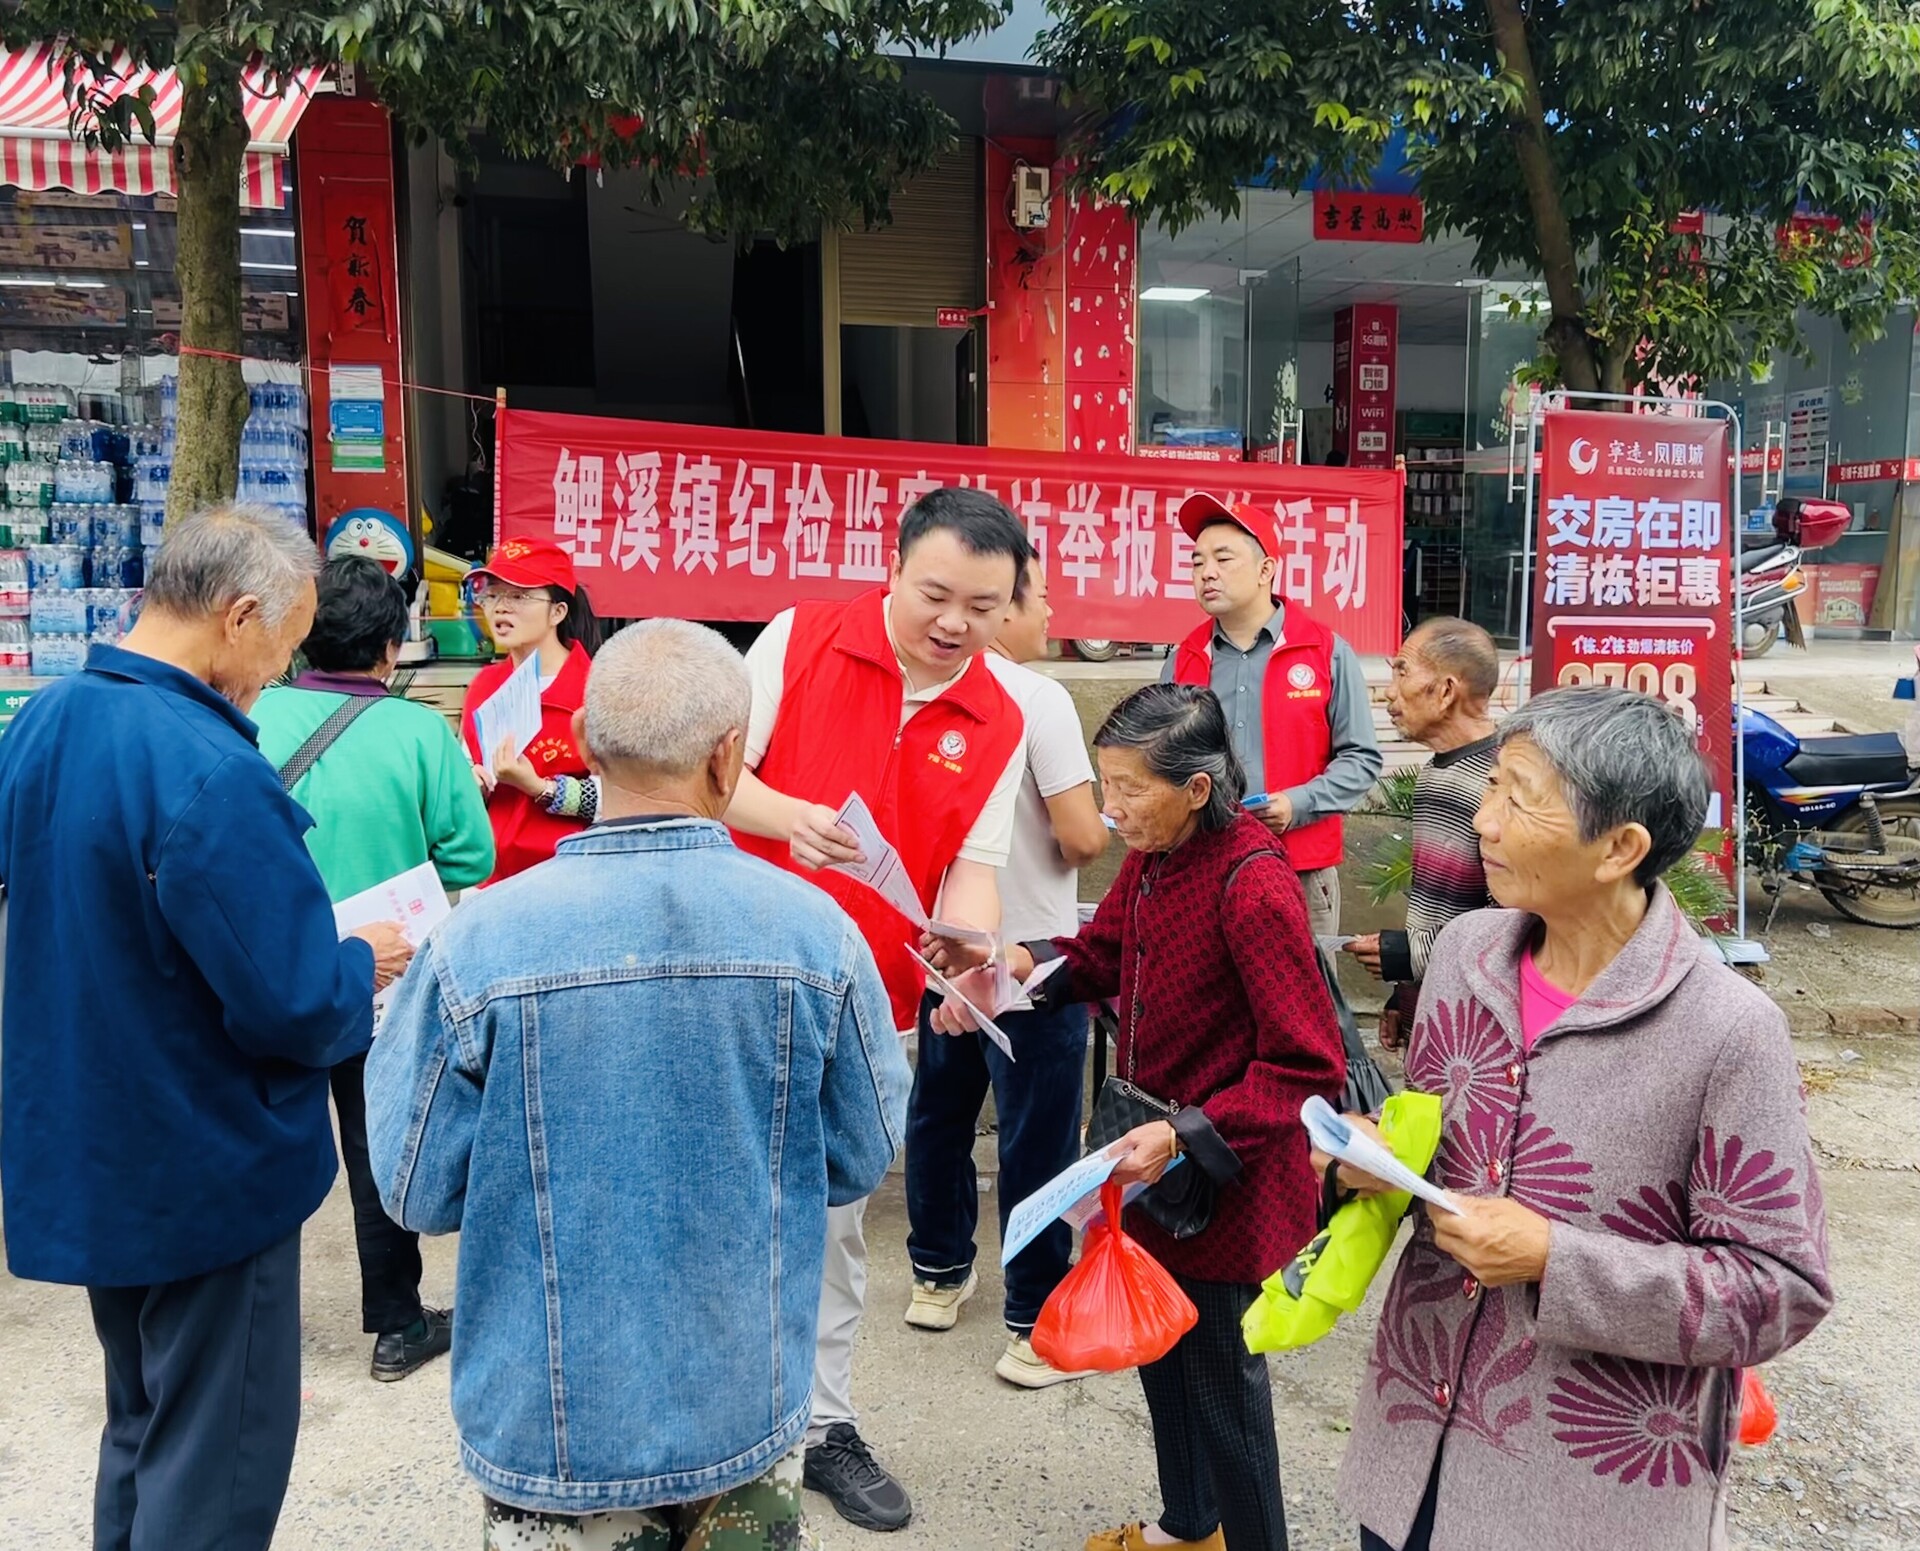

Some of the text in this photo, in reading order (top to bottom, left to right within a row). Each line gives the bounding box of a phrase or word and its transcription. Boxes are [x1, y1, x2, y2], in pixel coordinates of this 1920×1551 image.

[1322, 204, 1417, 232] 吉星高照
[1361, 408, 1385, 418] WiFi
[1547, 494, 1722, 551] 交房在即
[1543, 552, 1723, 607] 清栋钜惠
